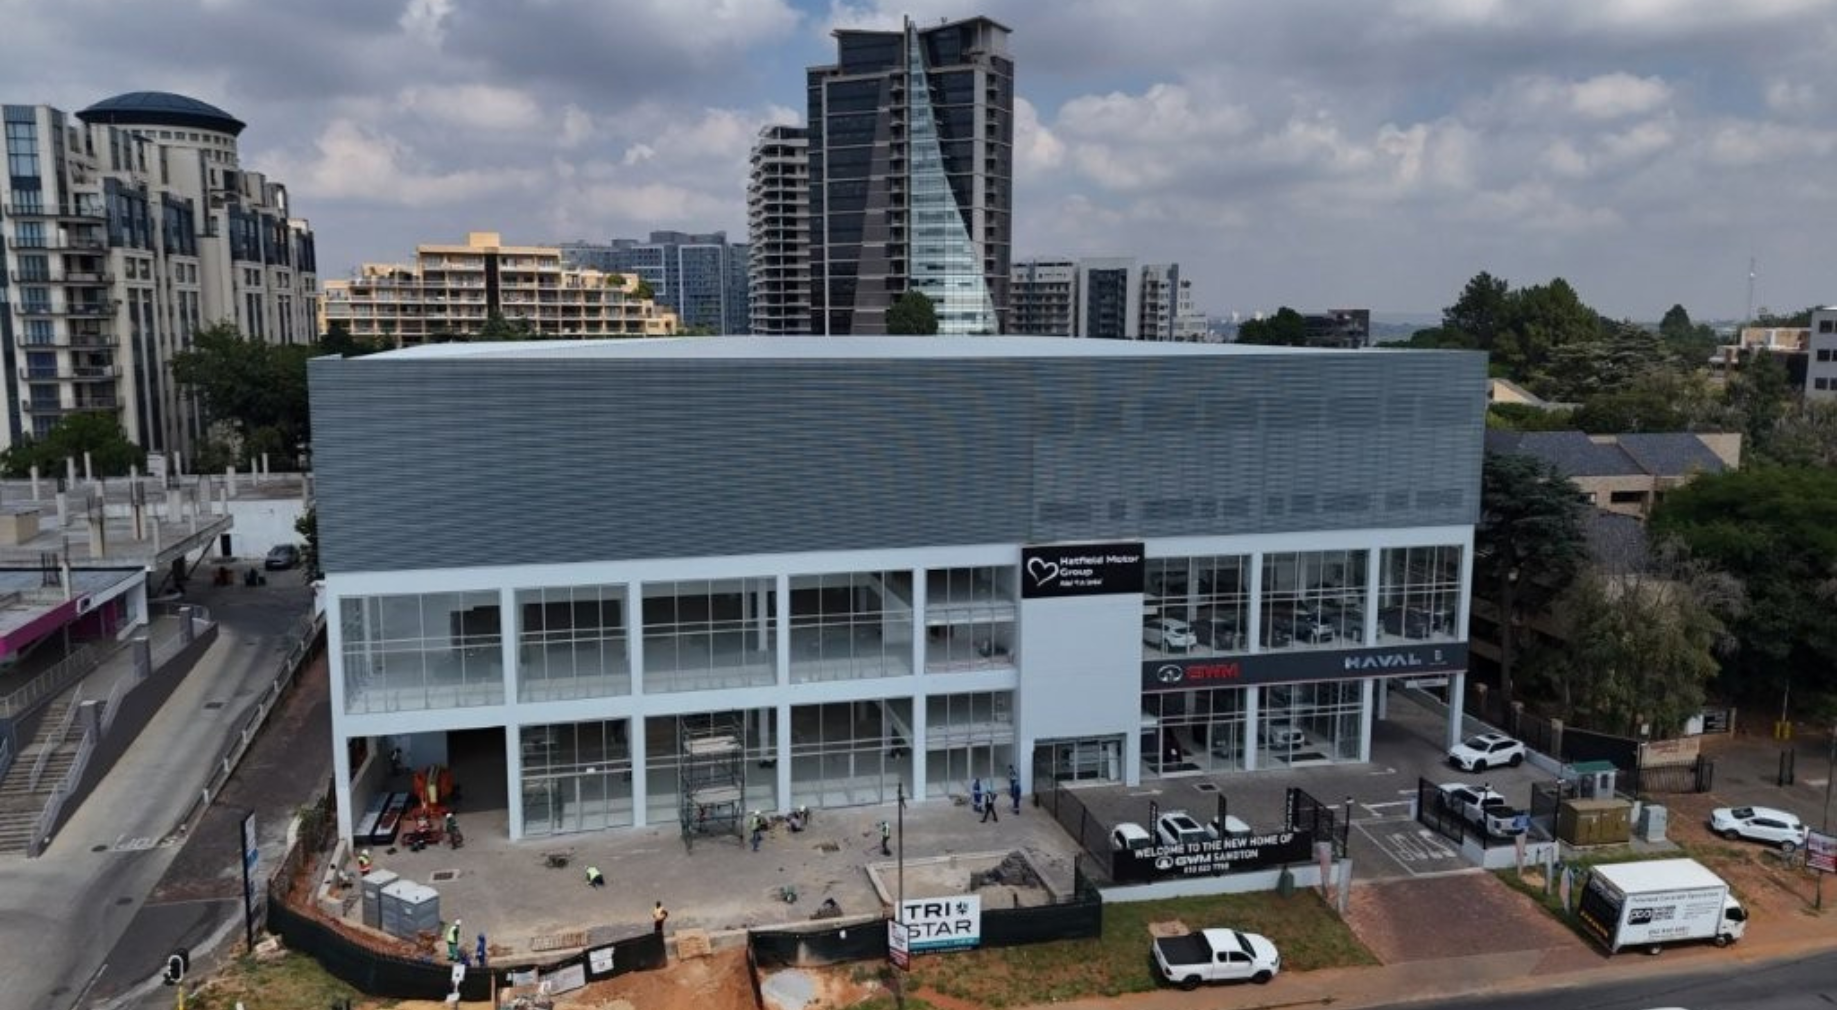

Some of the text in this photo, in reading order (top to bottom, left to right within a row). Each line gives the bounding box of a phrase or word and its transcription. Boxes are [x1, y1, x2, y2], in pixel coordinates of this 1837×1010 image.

[1060, 554, 1140, 566] Hatfield Motor
[1060, 567, 1094, 577] Group
[1344, 652, 1422, 670] HAVAL
[1186, 663, 1239, 679] GWM
[1134, 832, 1294, 859] WELCOME TO THE NEW HOME OF
[1175, 848, 1259, 867] GWM SANDTON
[904, 902, 950, 920] TRI
[908, 920, 972, 939] STAR
